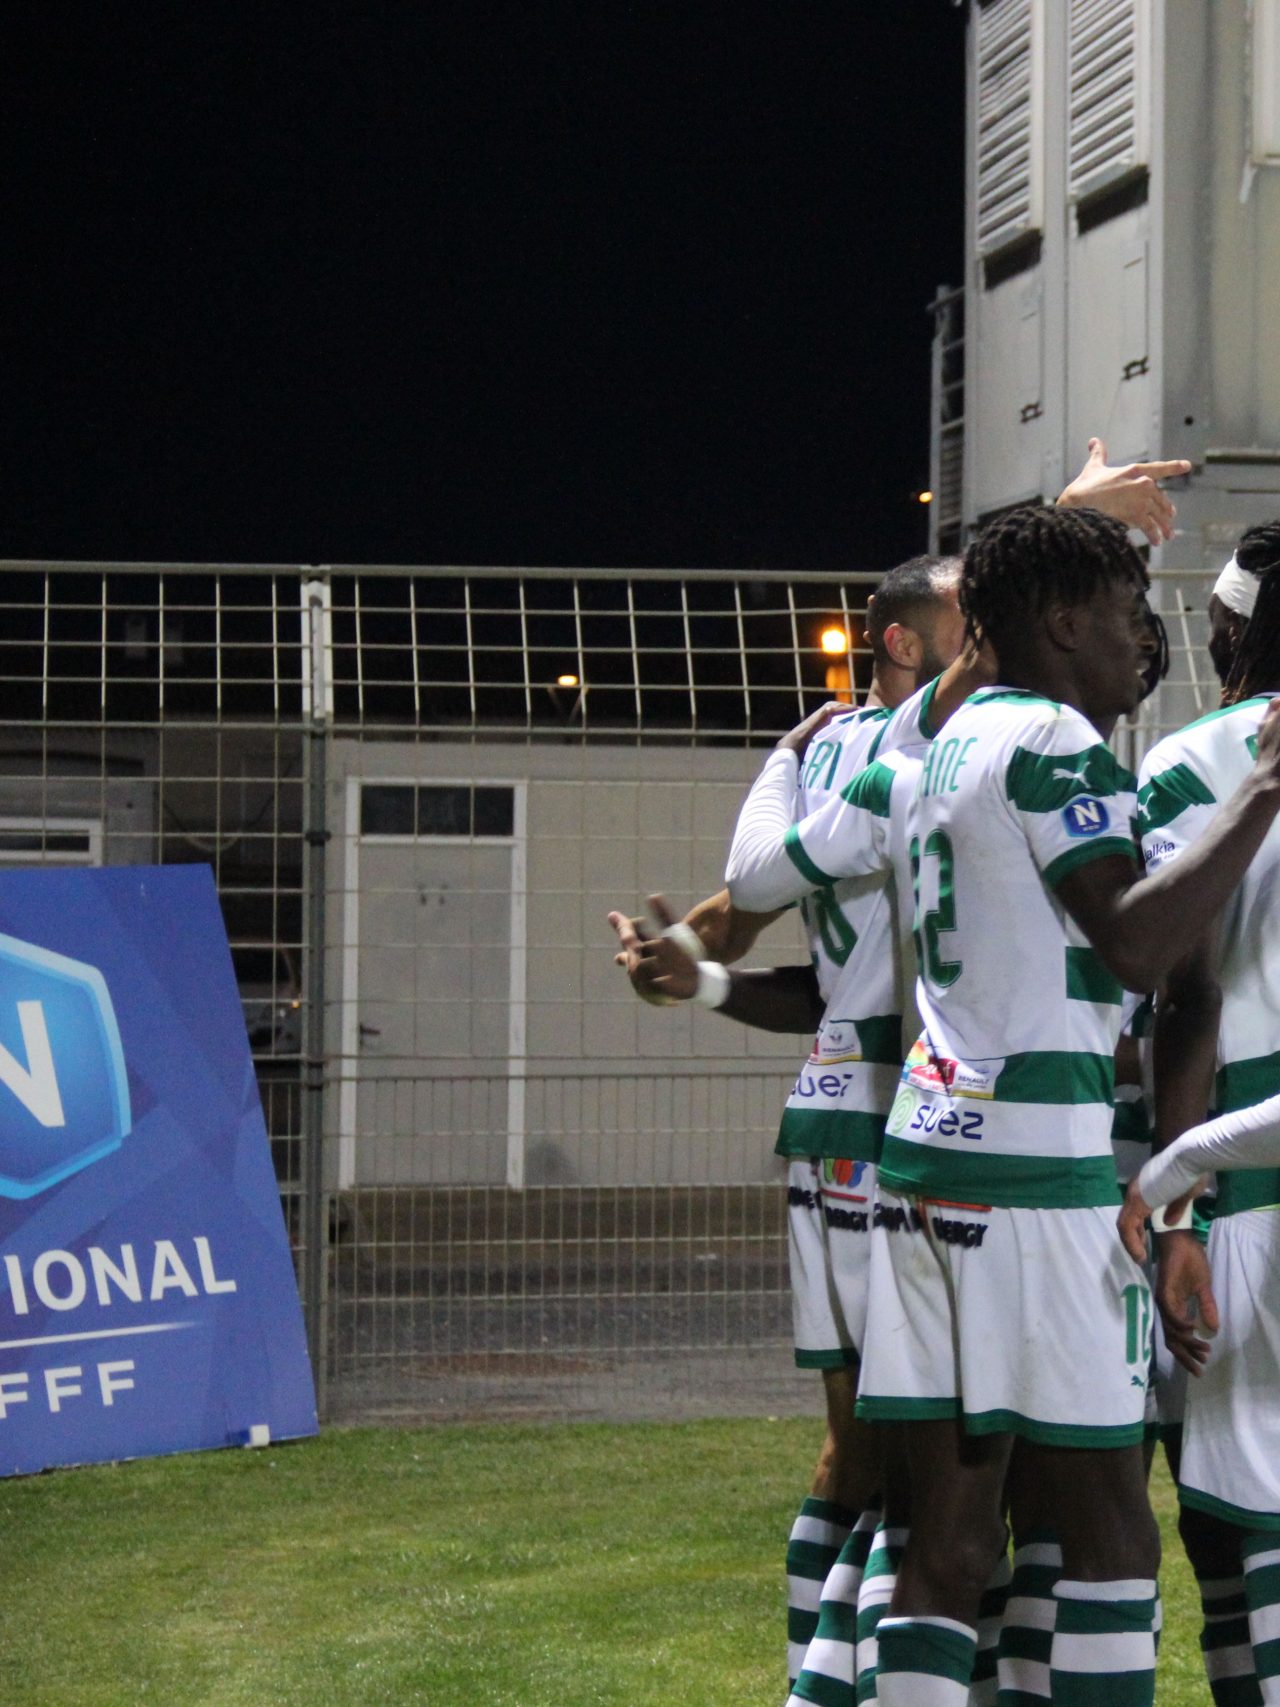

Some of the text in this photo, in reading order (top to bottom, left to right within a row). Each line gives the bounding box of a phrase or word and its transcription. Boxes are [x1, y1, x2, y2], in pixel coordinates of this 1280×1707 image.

[1072, 801, 1101, 826] N
[911, 1104, 984, 1140] suez
[0, 1360, 135, 1419] FFF
